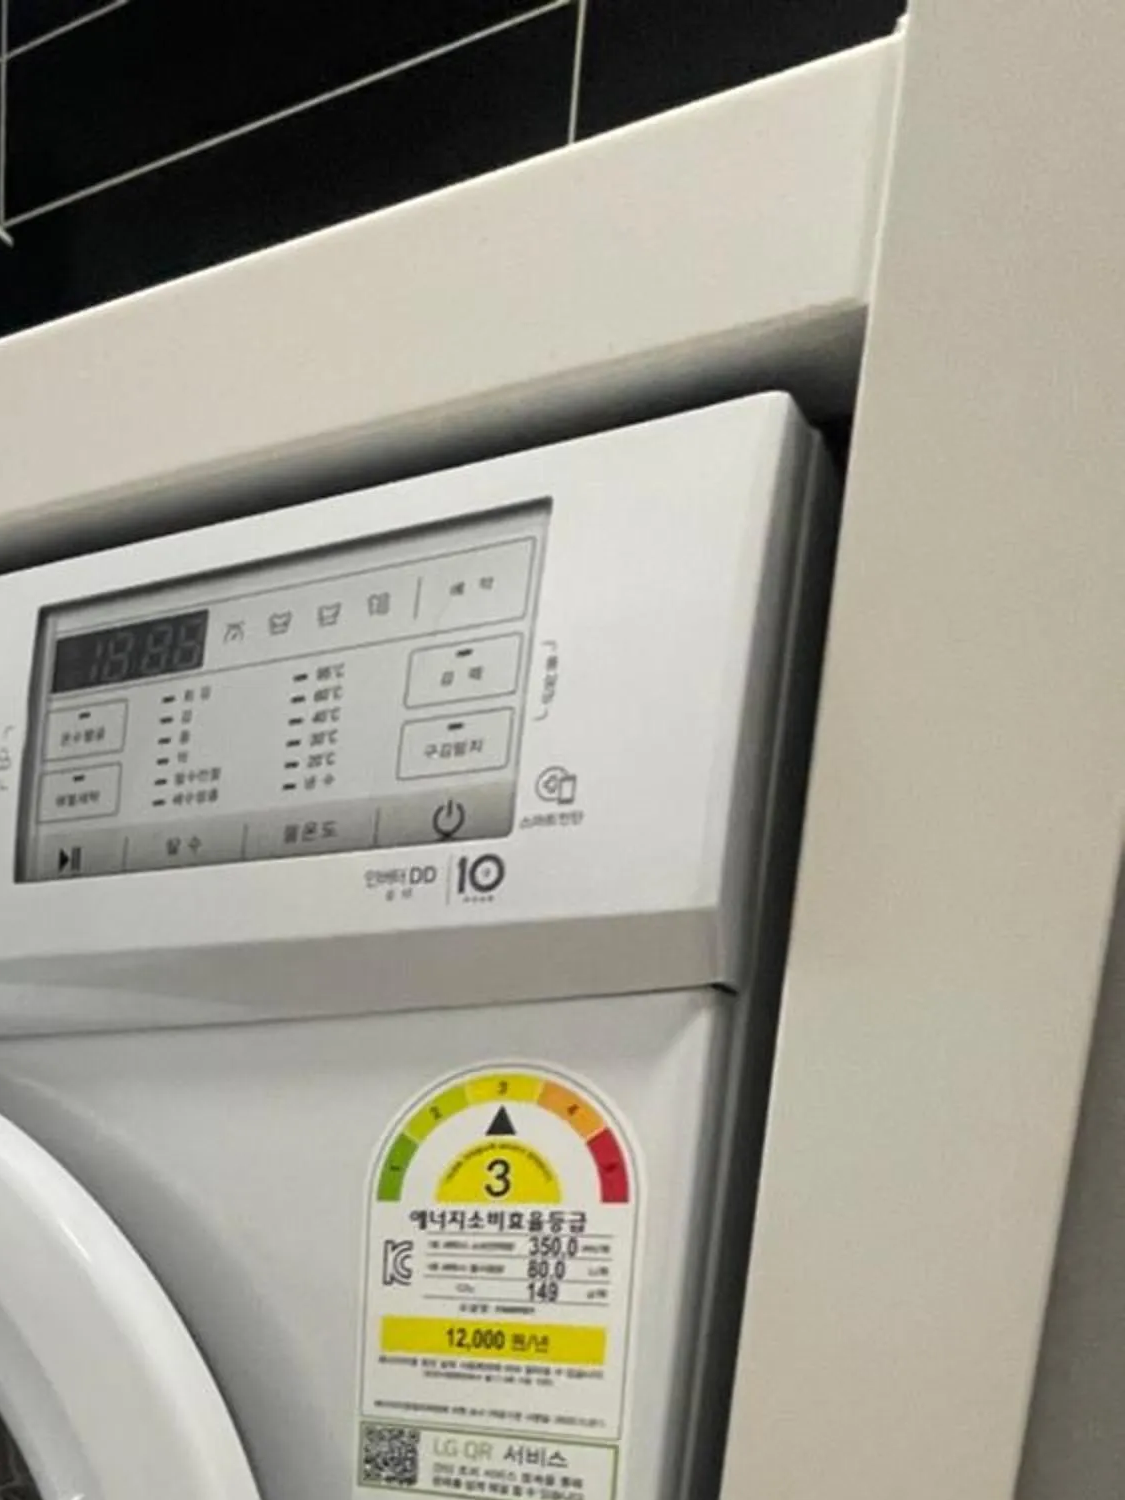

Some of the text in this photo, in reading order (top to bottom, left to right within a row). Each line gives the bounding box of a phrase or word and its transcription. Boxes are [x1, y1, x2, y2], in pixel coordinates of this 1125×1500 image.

[484, 1158, 513, 1198] 3
[408, 1209, 588, 1234] 에너지소비효율등급
[527, 1283, 559, 1303] 149
[445, 1327, 506, 1351] 12,000
[433, 1438, 459, 1459] LG
[503, 1444, 569, 1469] 서비스
